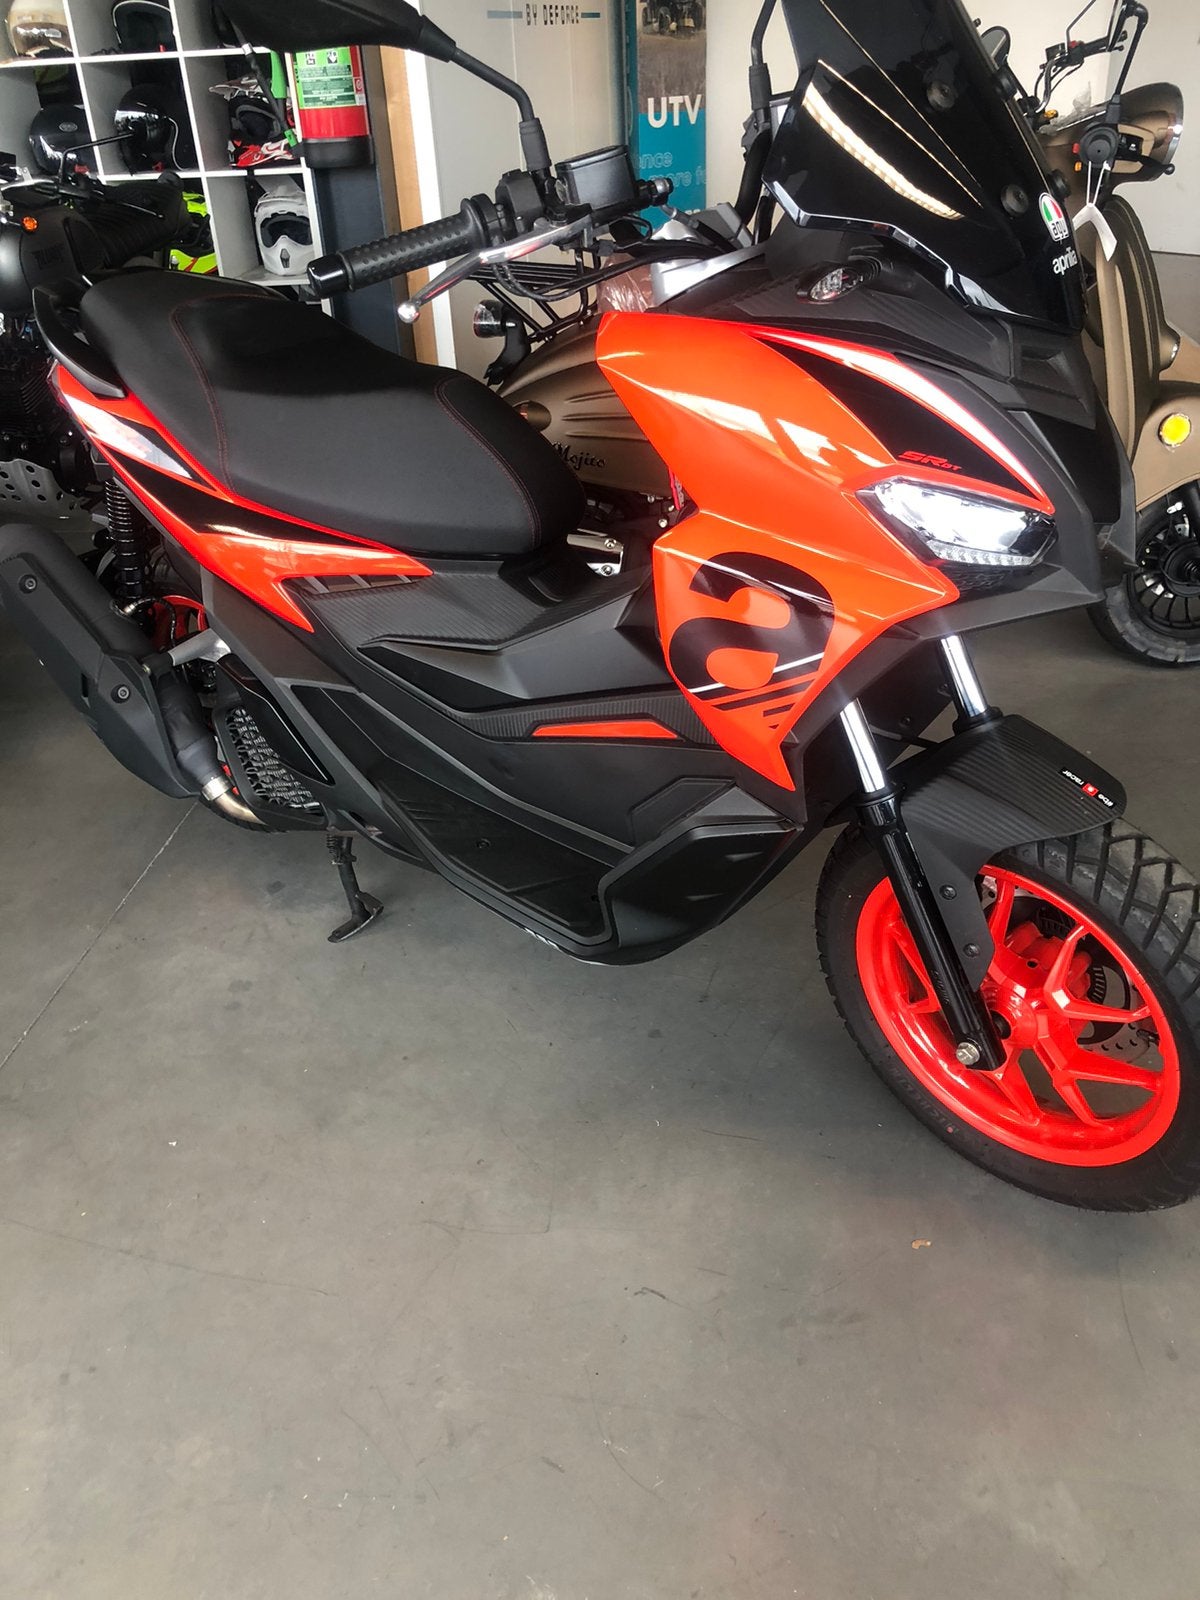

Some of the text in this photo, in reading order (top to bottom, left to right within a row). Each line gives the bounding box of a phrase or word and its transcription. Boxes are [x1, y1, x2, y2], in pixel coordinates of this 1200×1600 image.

[525, 3, 580, 26] BY DEFORCE
[647, 94, 702, 128] UTV
[1052, 246, 1078, 275] aprilia
